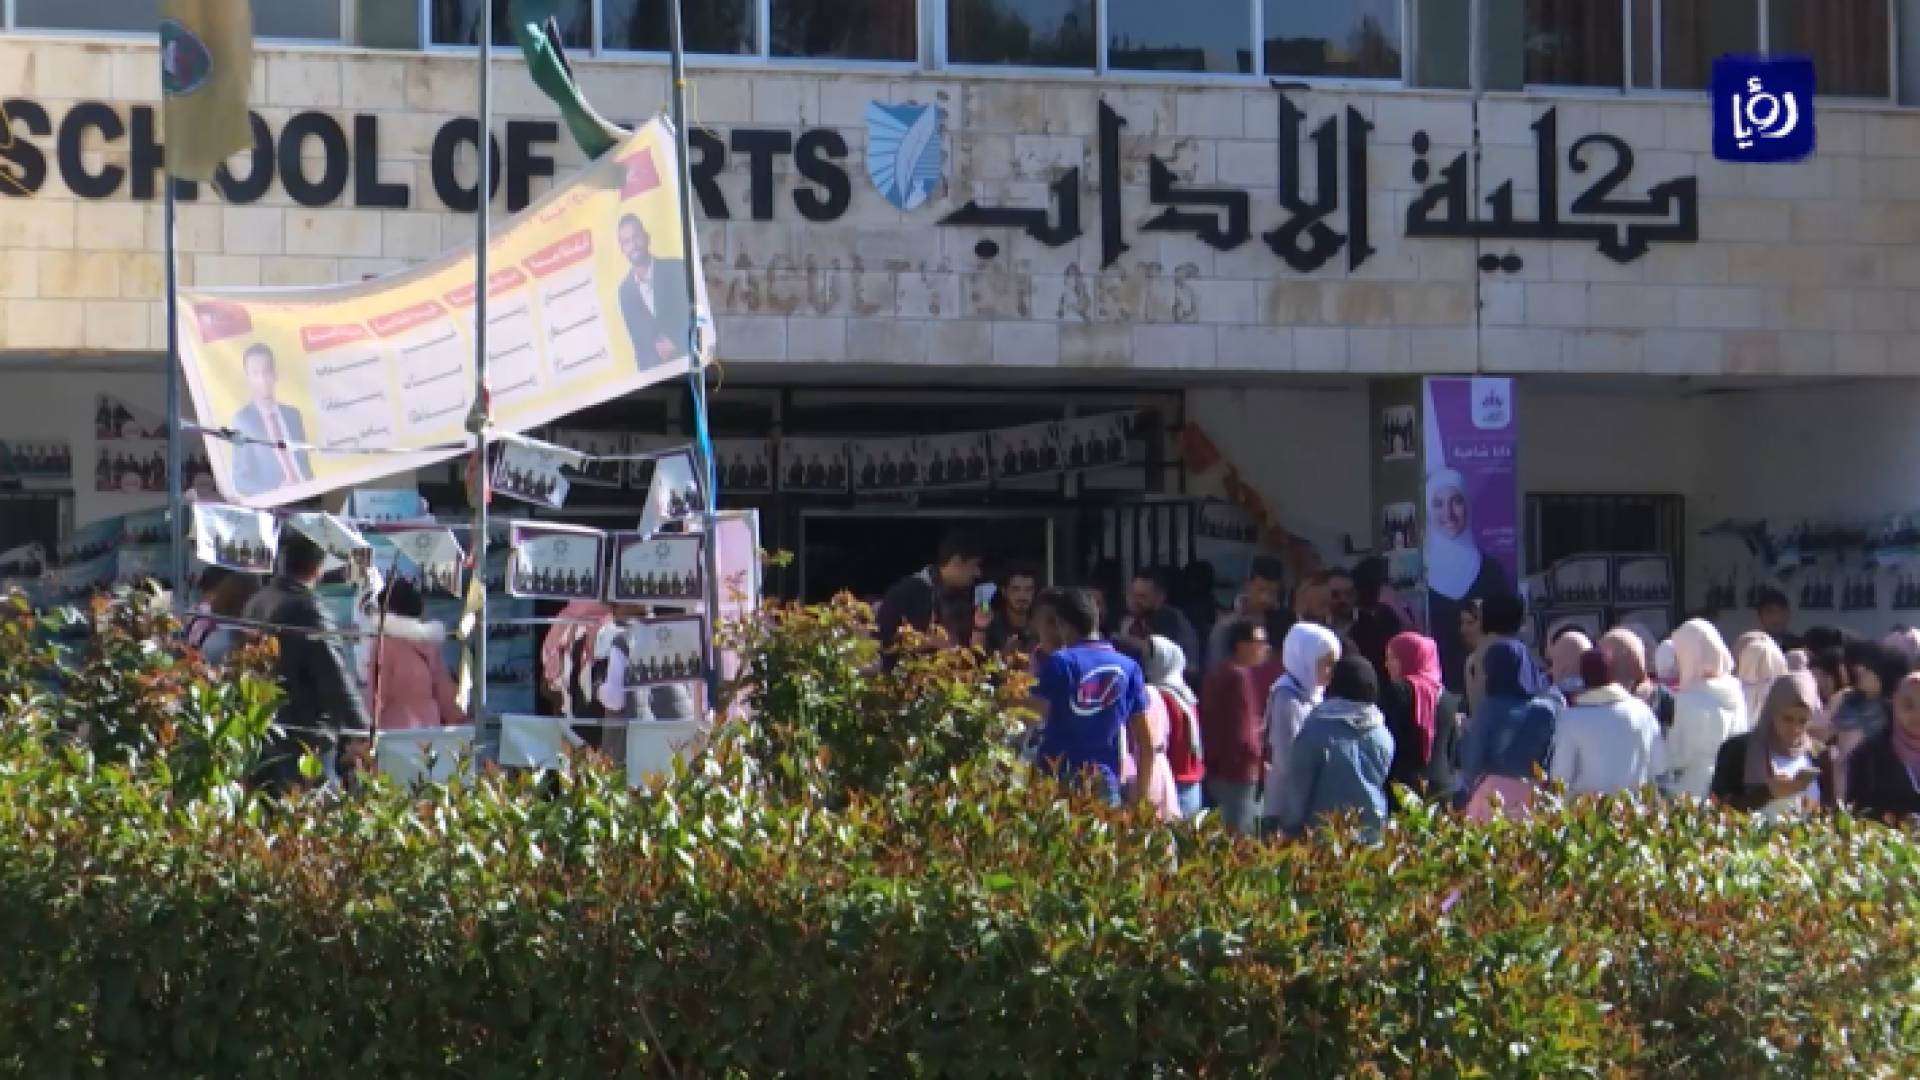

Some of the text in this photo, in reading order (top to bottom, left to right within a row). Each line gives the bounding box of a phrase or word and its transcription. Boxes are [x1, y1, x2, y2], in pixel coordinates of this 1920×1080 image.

[431, 117, 558, 215] OF
[625, 124, 852, 223] RTS
[1404, 105, 1699, 275] كلية
